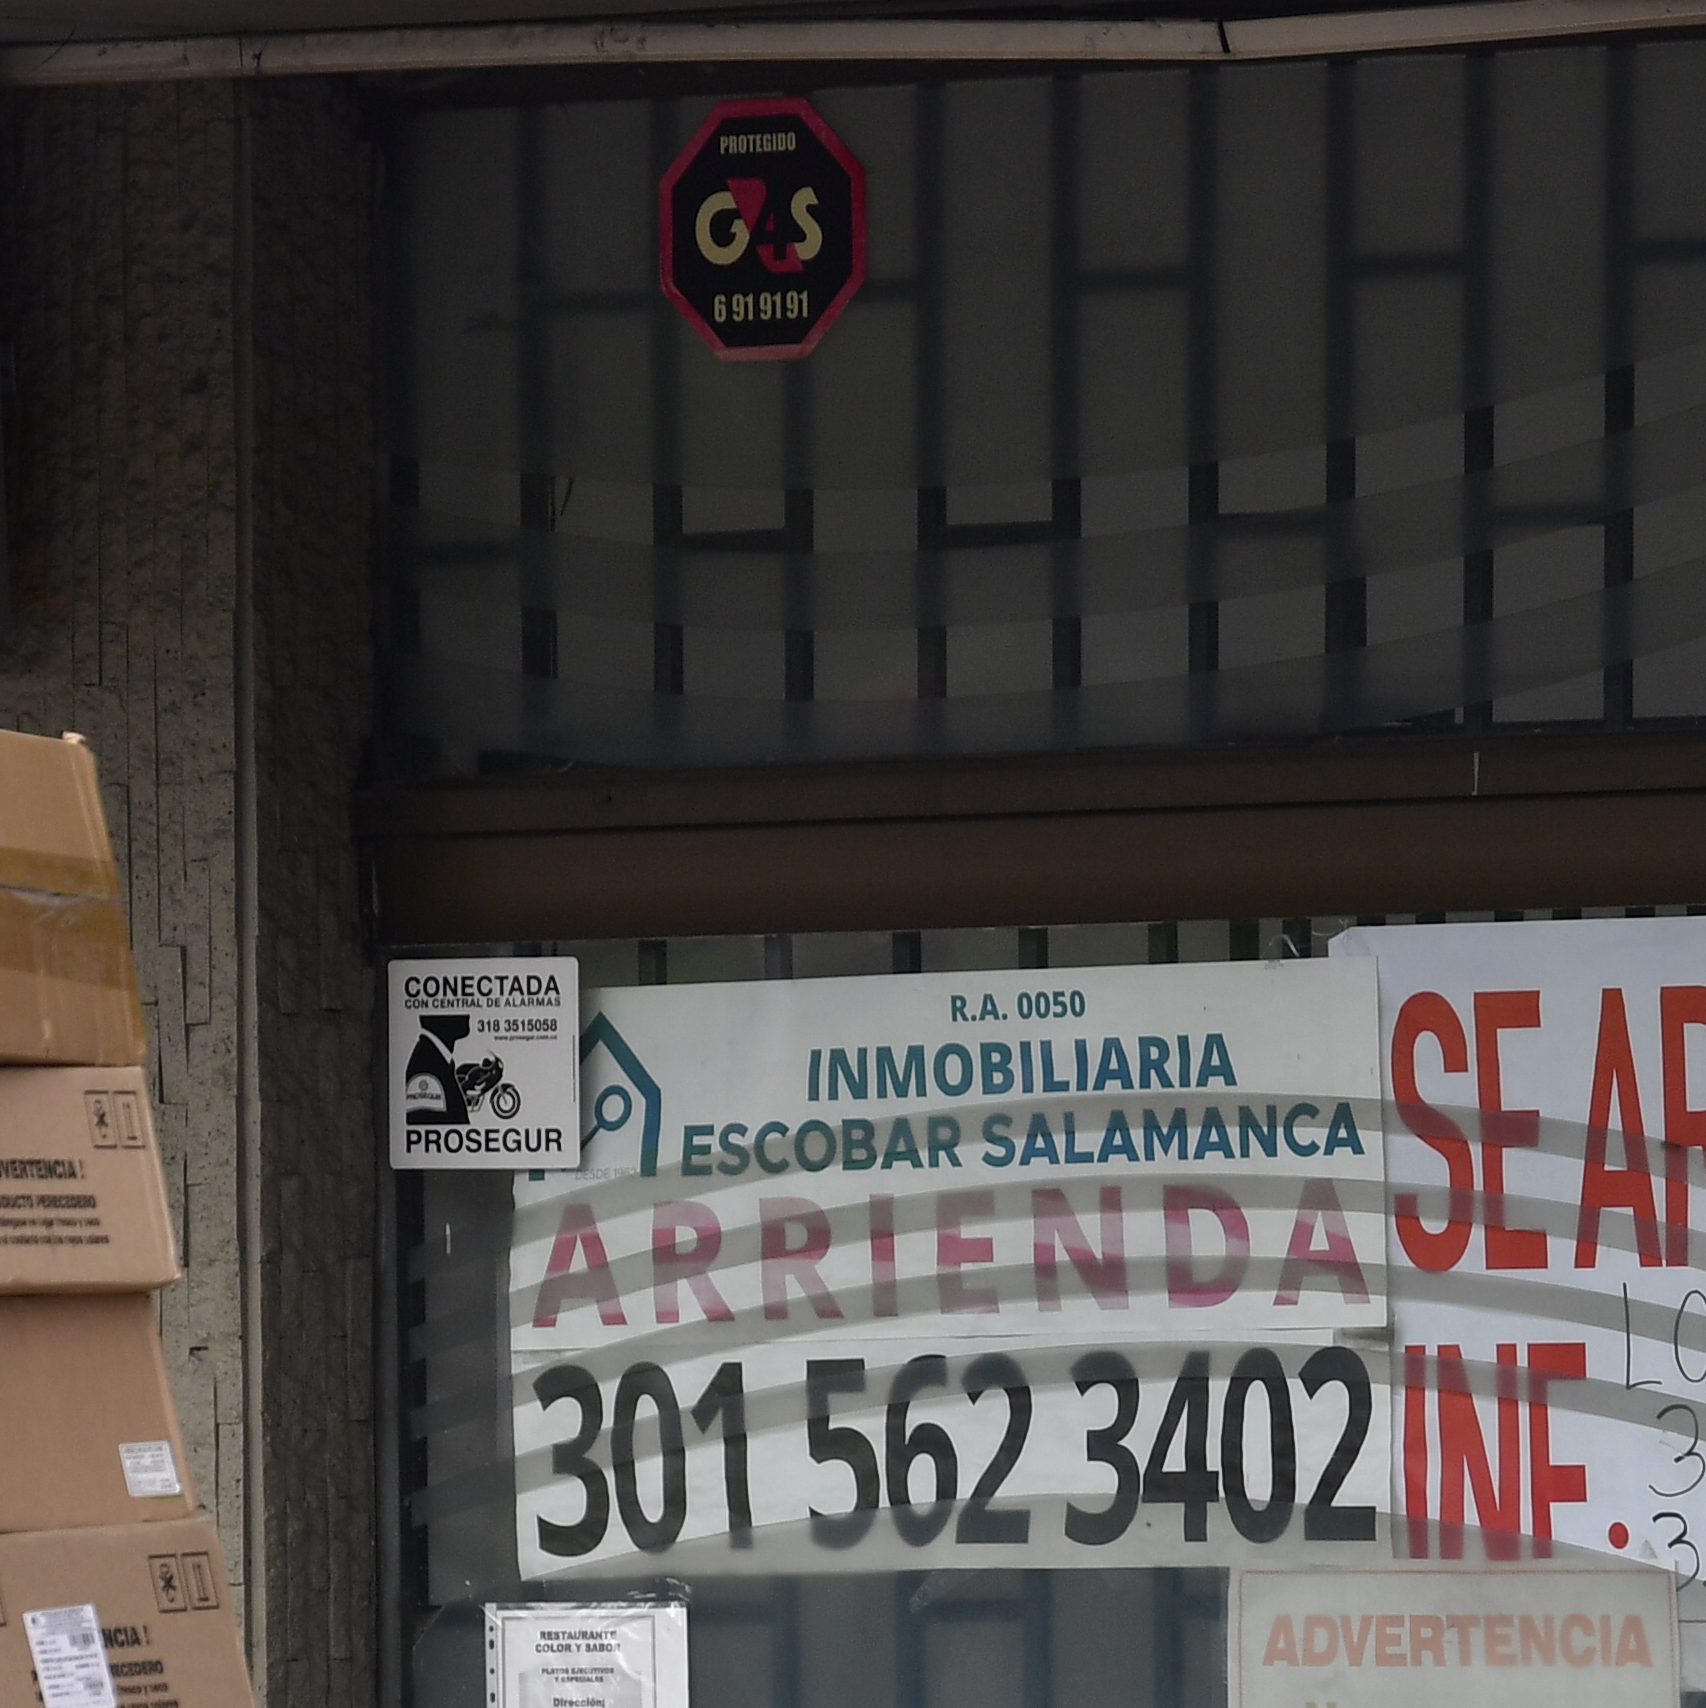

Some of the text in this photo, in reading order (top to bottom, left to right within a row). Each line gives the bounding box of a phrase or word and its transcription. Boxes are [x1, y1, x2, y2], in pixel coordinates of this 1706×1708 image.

[720, 132, 796, 154] PROTEGIDO
[695, 177, 823, 273] G4S
[404, 975, 561, 998] CONECTADA
[404, 997, 561, 1009] CON CENTRAL DE ALARMAS
[950, 990, 1086, 1023] R.A. 0050
[477, 1018, 558, 1033] 318 3515058
[807, 1033, 1238, 1103] INMOBILIARIA
[405, 1128, 563, 1154] PROSEGUR
[681, 1102, 1366, 1177] ESCOBAR SALAMANCA
[1391, 990, 1549, 1272] SE
[532, 1177, 1371, 1329] ARRIENDA
[536, 1346, 1377, 1558] 301 562 3402
[1402, 1342, 1630, 1561] INF.
[535, 1643, 572, 1653] COLOR
[575, 1644, 582, 1652] Y
[540, 1630, 617, 1640] RESTAURANTE
[1263, 1613, 1653, 1667] ADVERTENCIA
